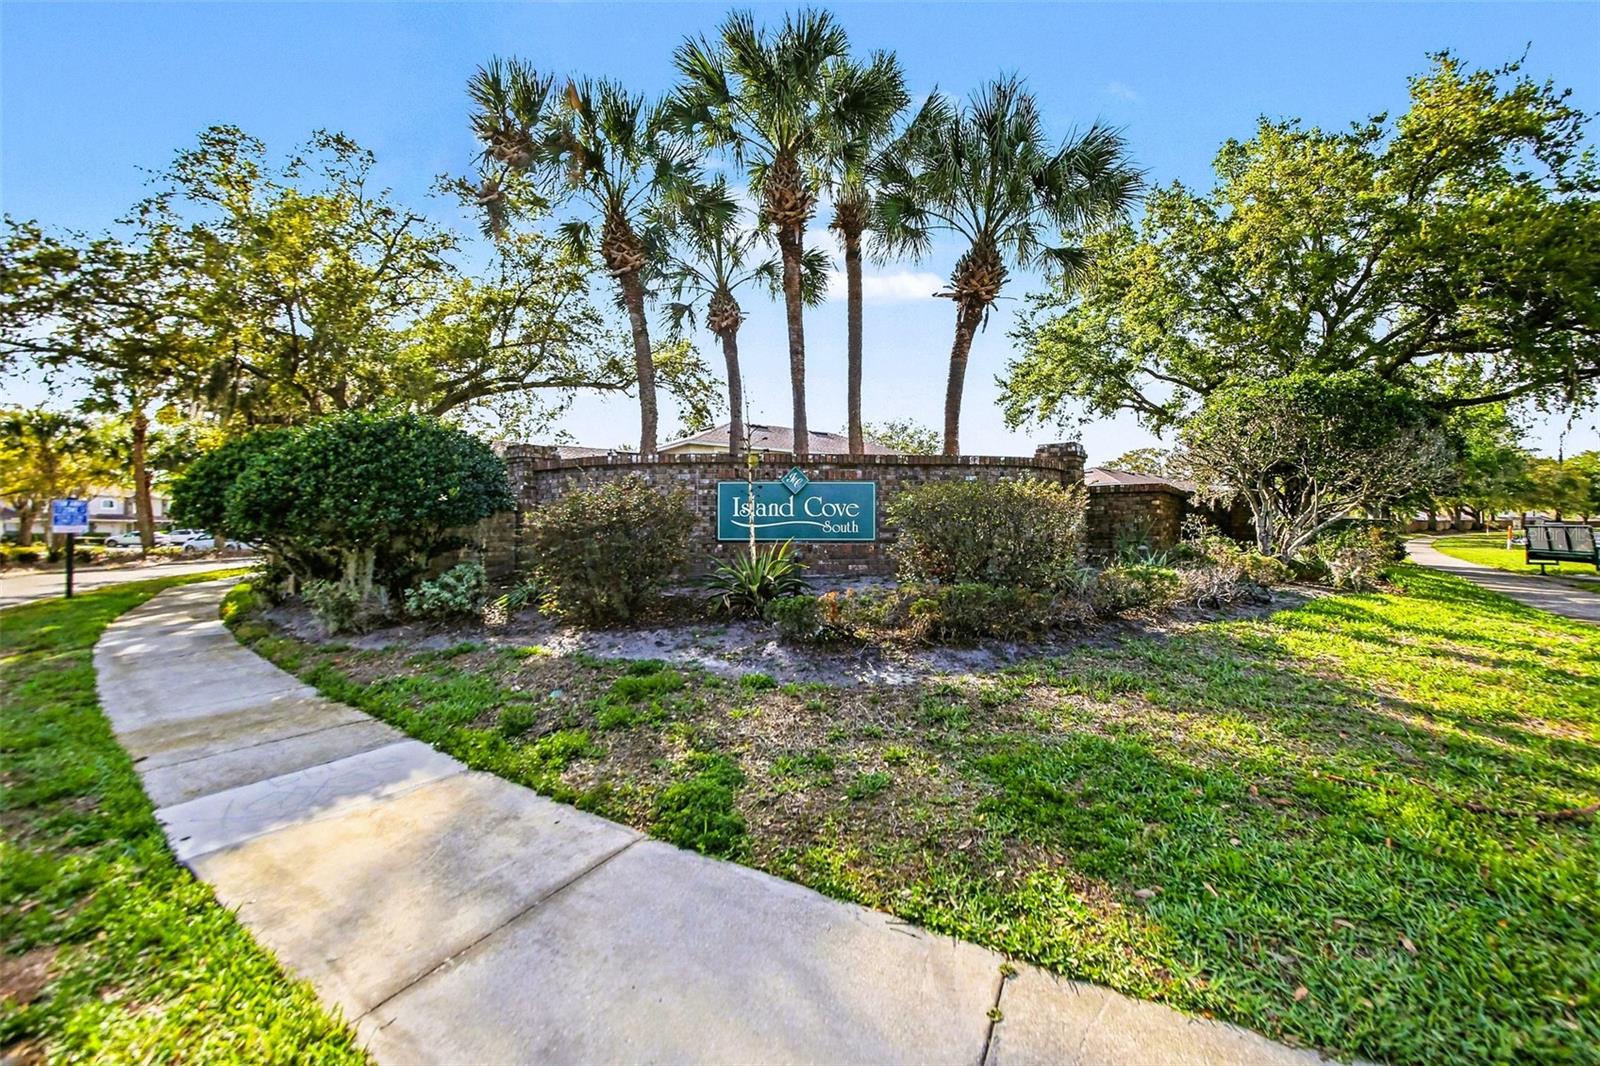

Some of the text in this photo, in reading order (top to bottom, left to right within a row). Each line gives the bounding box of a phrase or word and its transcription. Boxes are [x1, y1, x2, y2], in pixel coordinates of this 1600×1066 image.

[732, 495, 860, 518] Island Cove
[822, 520, 859, 533] South
